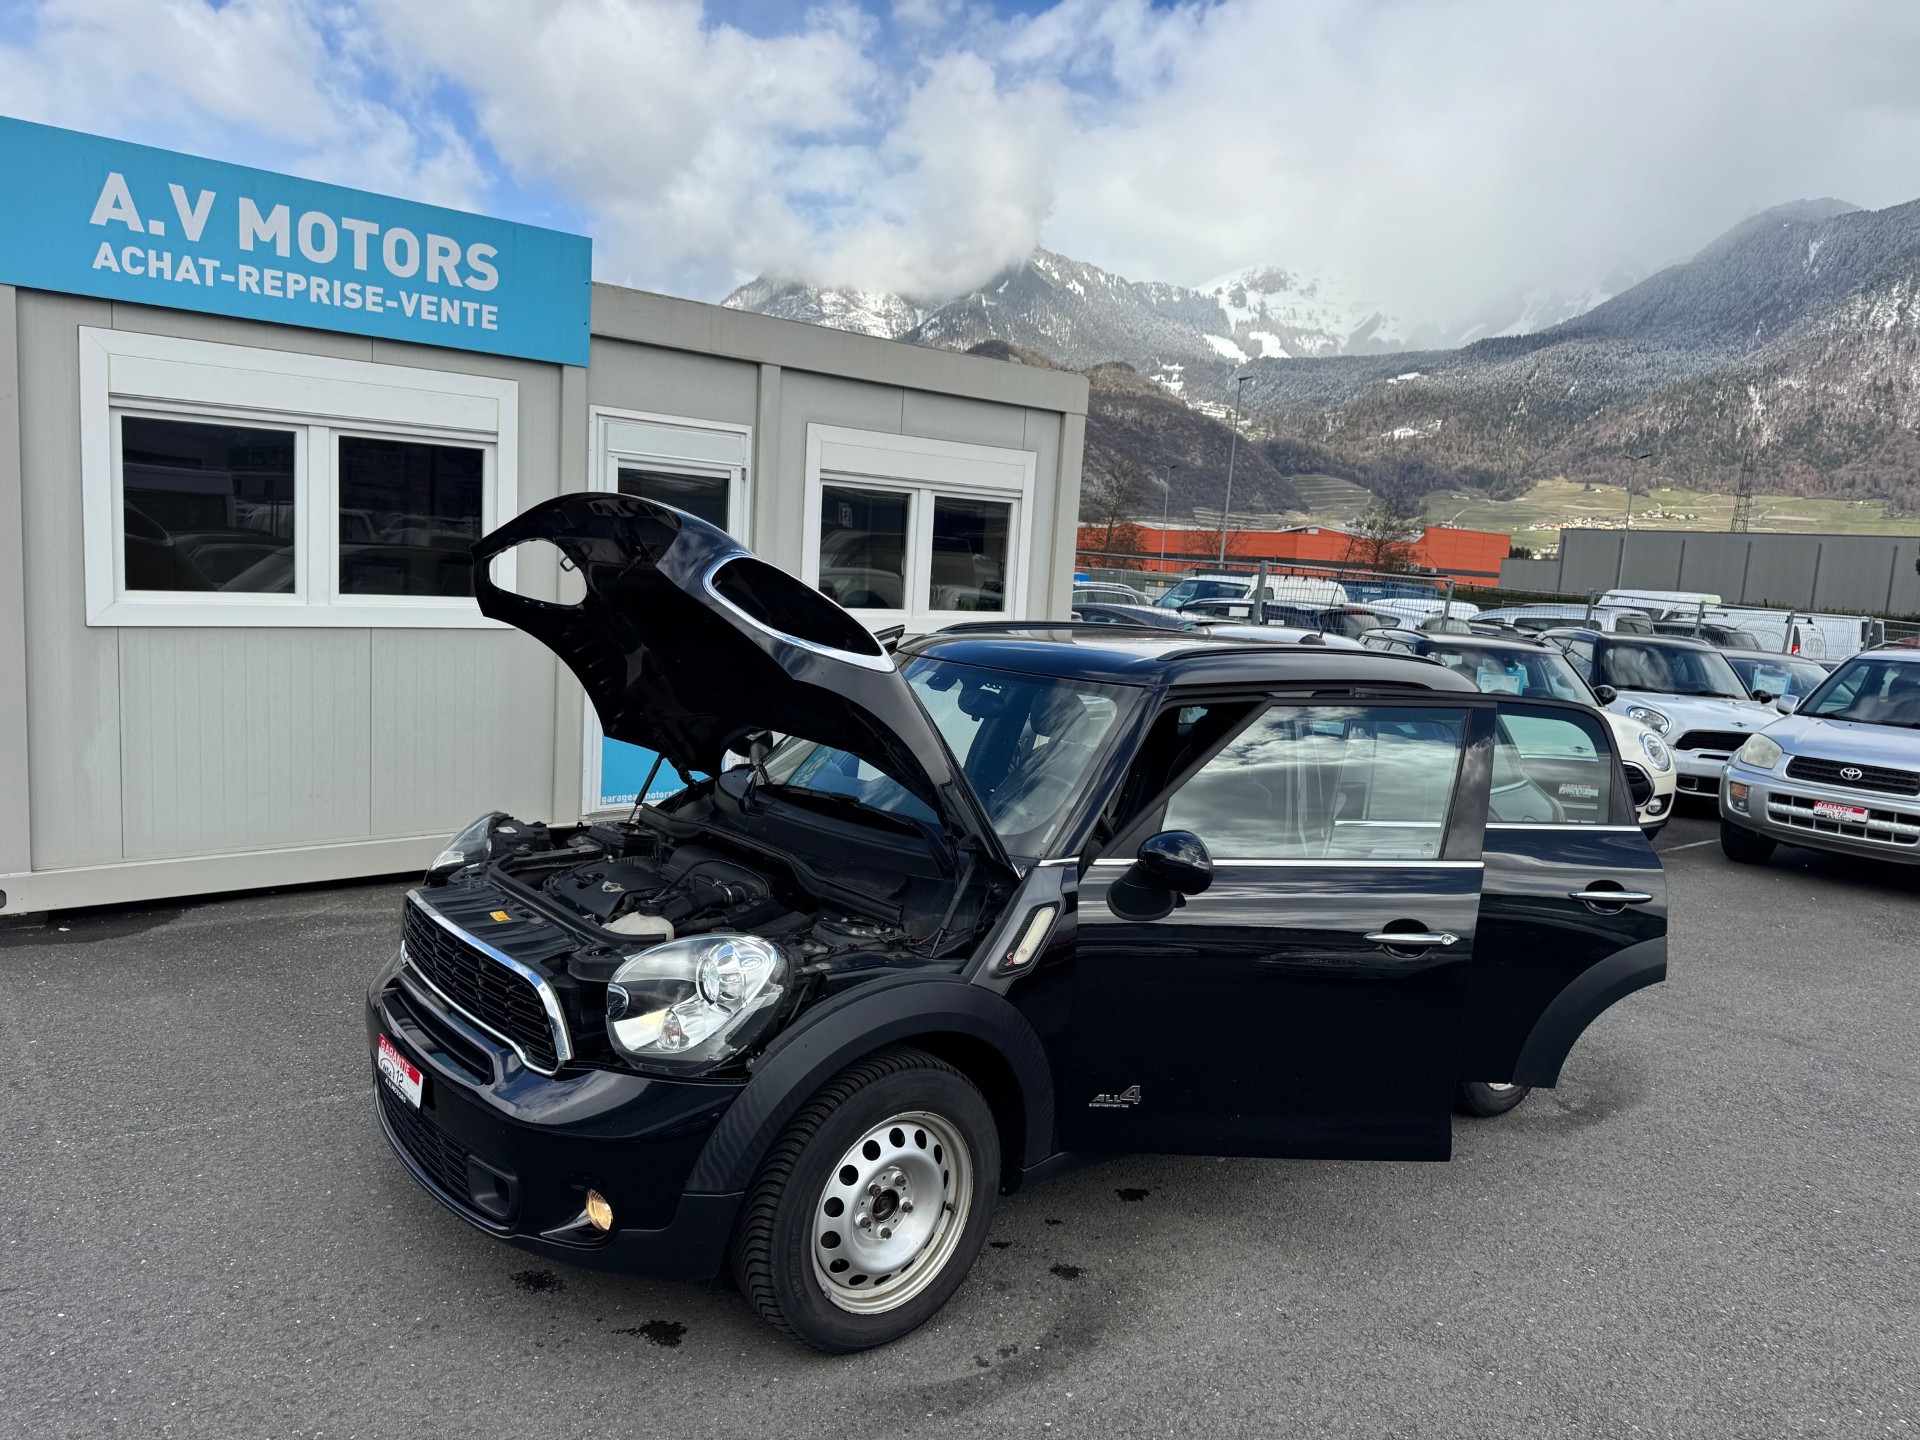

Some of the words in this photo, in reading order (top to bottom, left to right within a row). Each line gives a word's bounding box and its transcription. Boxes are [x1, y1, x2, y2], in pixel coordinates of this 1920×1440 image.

[89, 172, 217, 242] A.V
[239, 197, 499, 292] MOTORS
[92, 241, 499, 331] ACHAT-REPRISE-VENTE
[380, 1039, 411, 1077] GARANTIE
